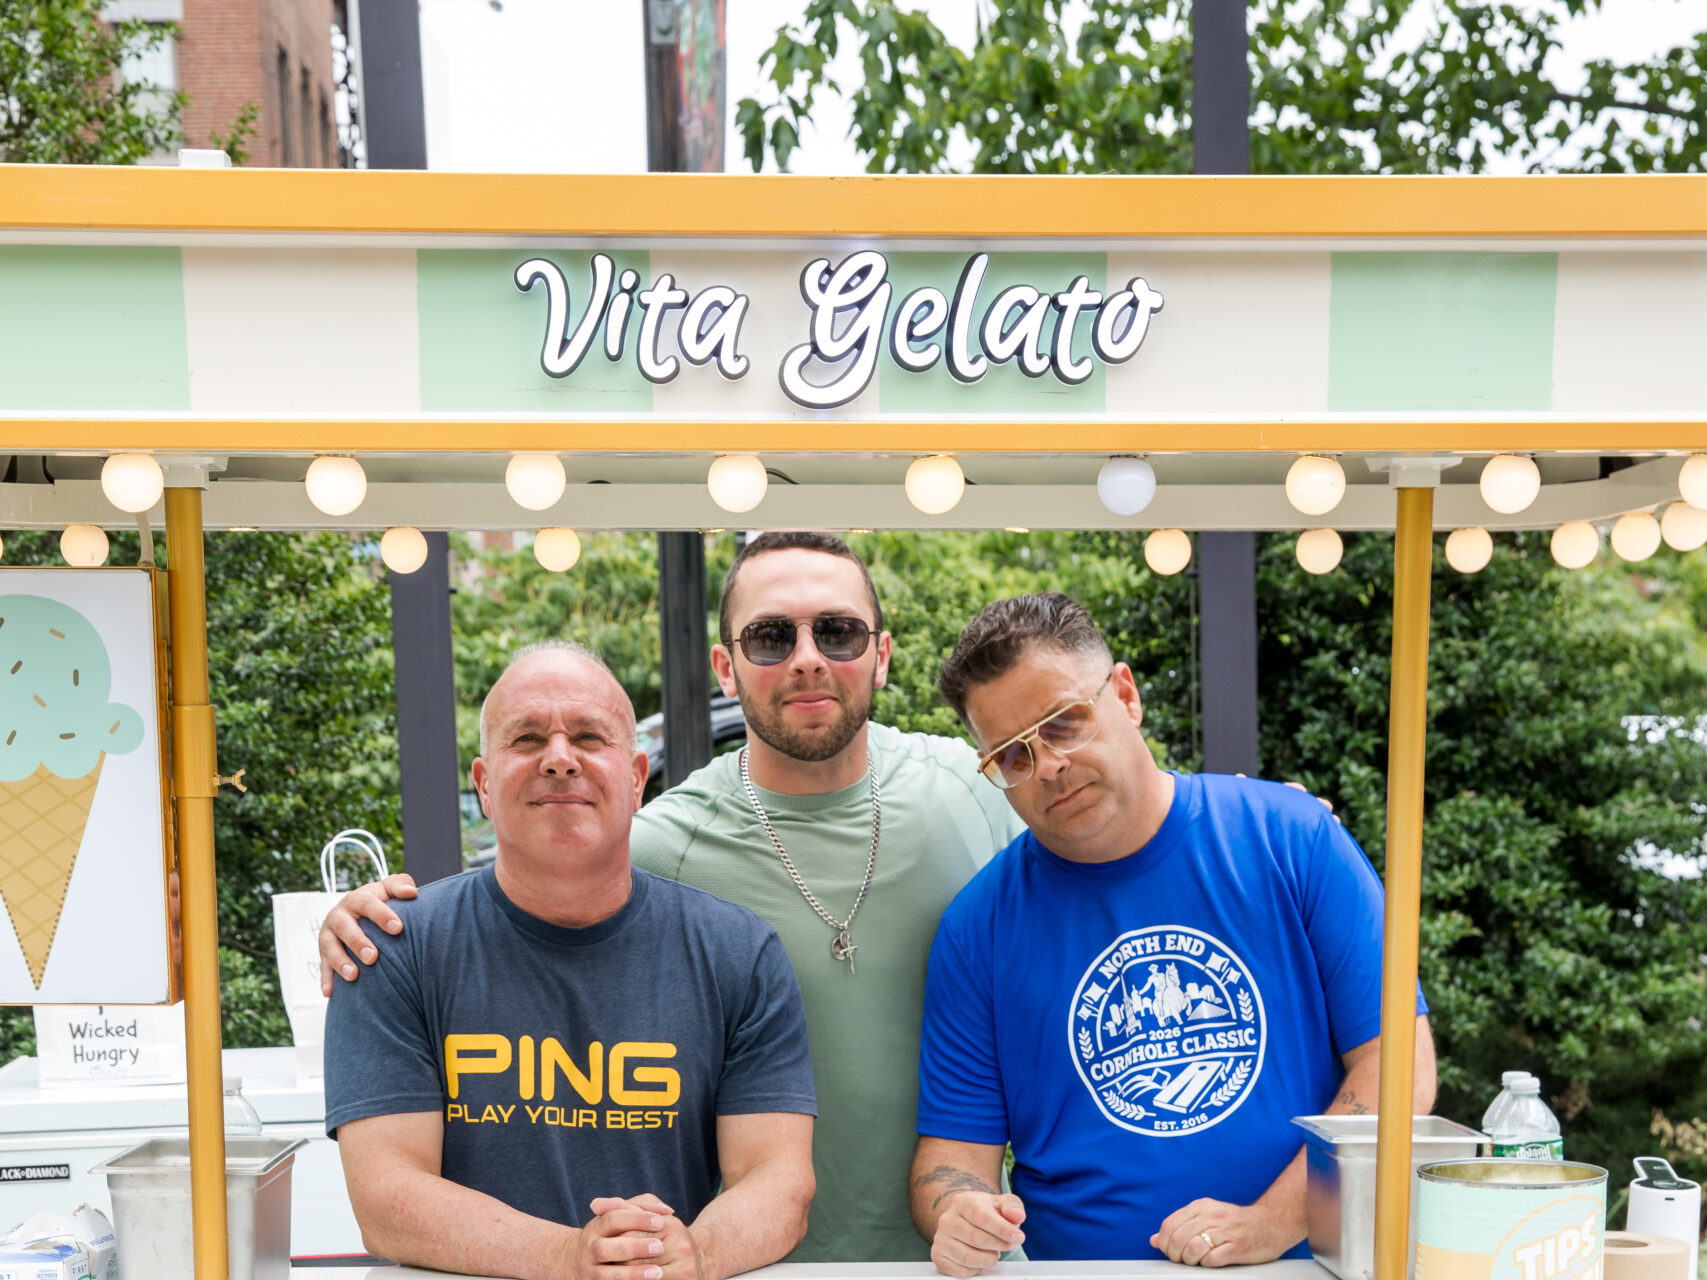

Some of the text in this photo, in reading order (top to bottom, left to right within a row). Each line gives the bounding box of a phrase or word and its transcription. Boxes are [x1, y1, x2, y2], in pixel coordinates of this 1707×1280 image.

[514, 250, 1163, 408] Vita Gelato
[1098, 934, 1206, 980] NORTH END
[69, 1019, 137, 1039] Wicked
[1149, 1027, 1181, 1041] 2026
[73, 1045, 139, 1067] Hungry
[1090, 1028, 1257, 1081] CORNHOLE CLASSIC
[444, 1033, 681, 1107] PING
[447, 1103, 679, 1130] PLAY YOUR BEST
[1154, 1112, 1209, 1131] EST. 2016
[0, 1166, 69, 1179] ACK DIAMOND
